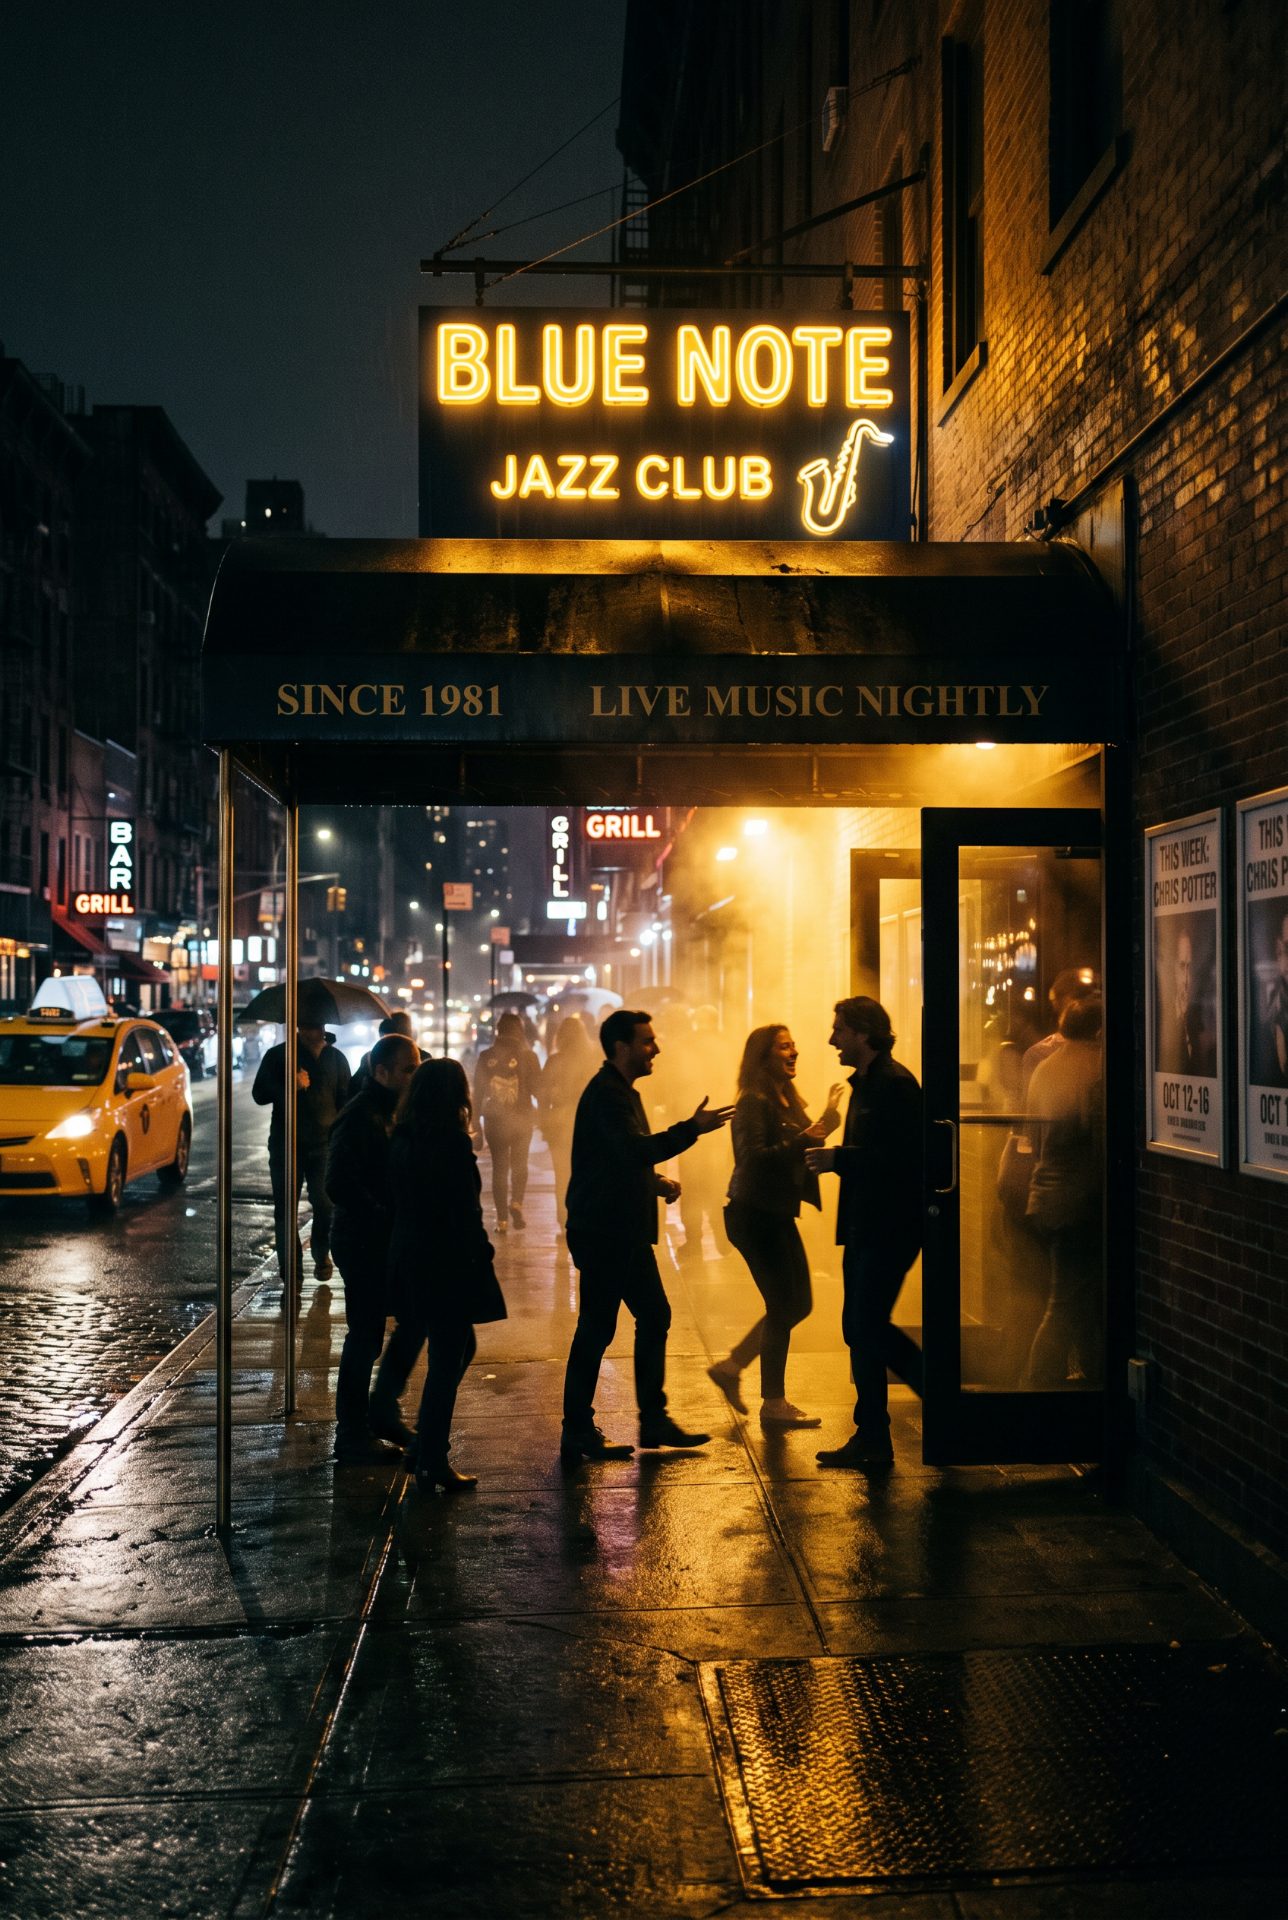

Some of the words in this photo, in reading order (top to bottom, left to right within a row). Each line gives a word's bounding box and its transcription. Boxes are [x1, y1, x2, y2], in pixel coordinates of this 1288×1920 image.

[436, 322, 649, 406] BLUE
[677, 324, 894, 409] NOTE
[490, 454, 620, 500] JAZZ
[635, 455, 773, 500] CLUB
[277, 683, 407, 717] SINCE
[420, 684, 503, 717] 1981
[589, 685, 691, 717] LIVE
[703, 685, 845, 718] MUSIC
[855, 685, 1048, 717] NIGHTLY
[586, 814, 661, 839] GRILL
[1258, 815, 1284, 850] THIS
[110, 821, 132, 889] BAR
[551, 815, 570, 898] GRILL
[1160, 842, 1179, 872] THIS
[1181, 836, 1210, 869] WEEK:
[1153, 878, 1179, 908] CHRIS
[1181, 871, 1217, 904] POTTER
[1246, 857, 1279, 893] CHRIS
[75, 894, 134, 914] GRILL
[1163, 1082, 1180, 1110] OCT
[1182, 1084, 1210, 1115] 12-16
[1260, 1094, 1281, 1126] OCT
